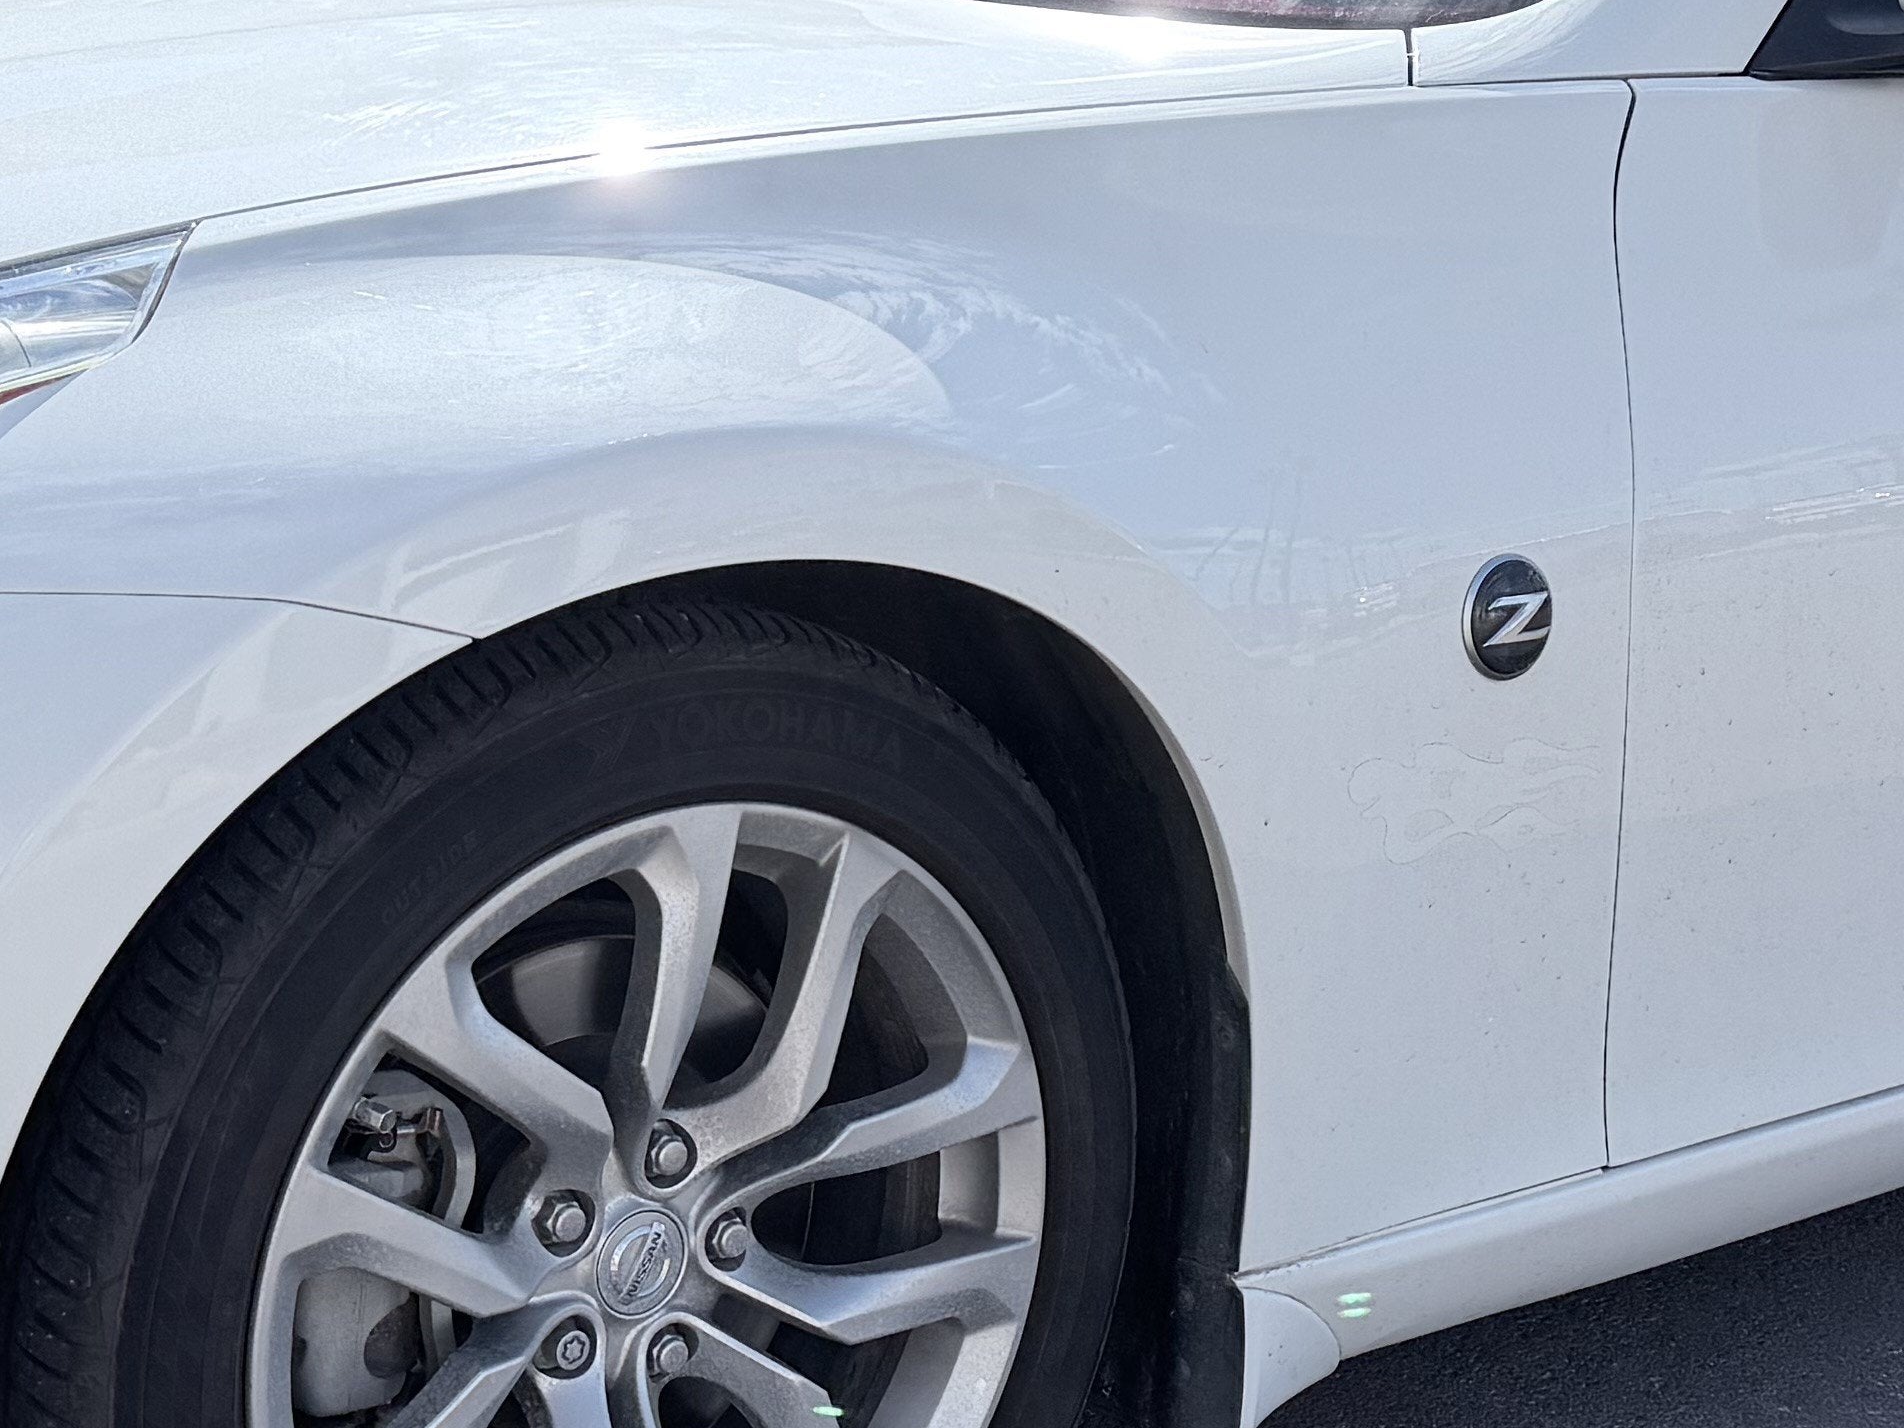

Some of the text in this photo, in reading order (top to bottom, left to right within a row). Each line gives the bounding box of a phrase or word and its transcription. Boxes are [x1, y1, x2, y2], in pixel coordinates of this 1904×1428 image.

[1482, 591, 1551, 647] Z
[648, 699, 905, 775] YOKOHAMA
[626, 1231, 663, 1299] NISSAN
